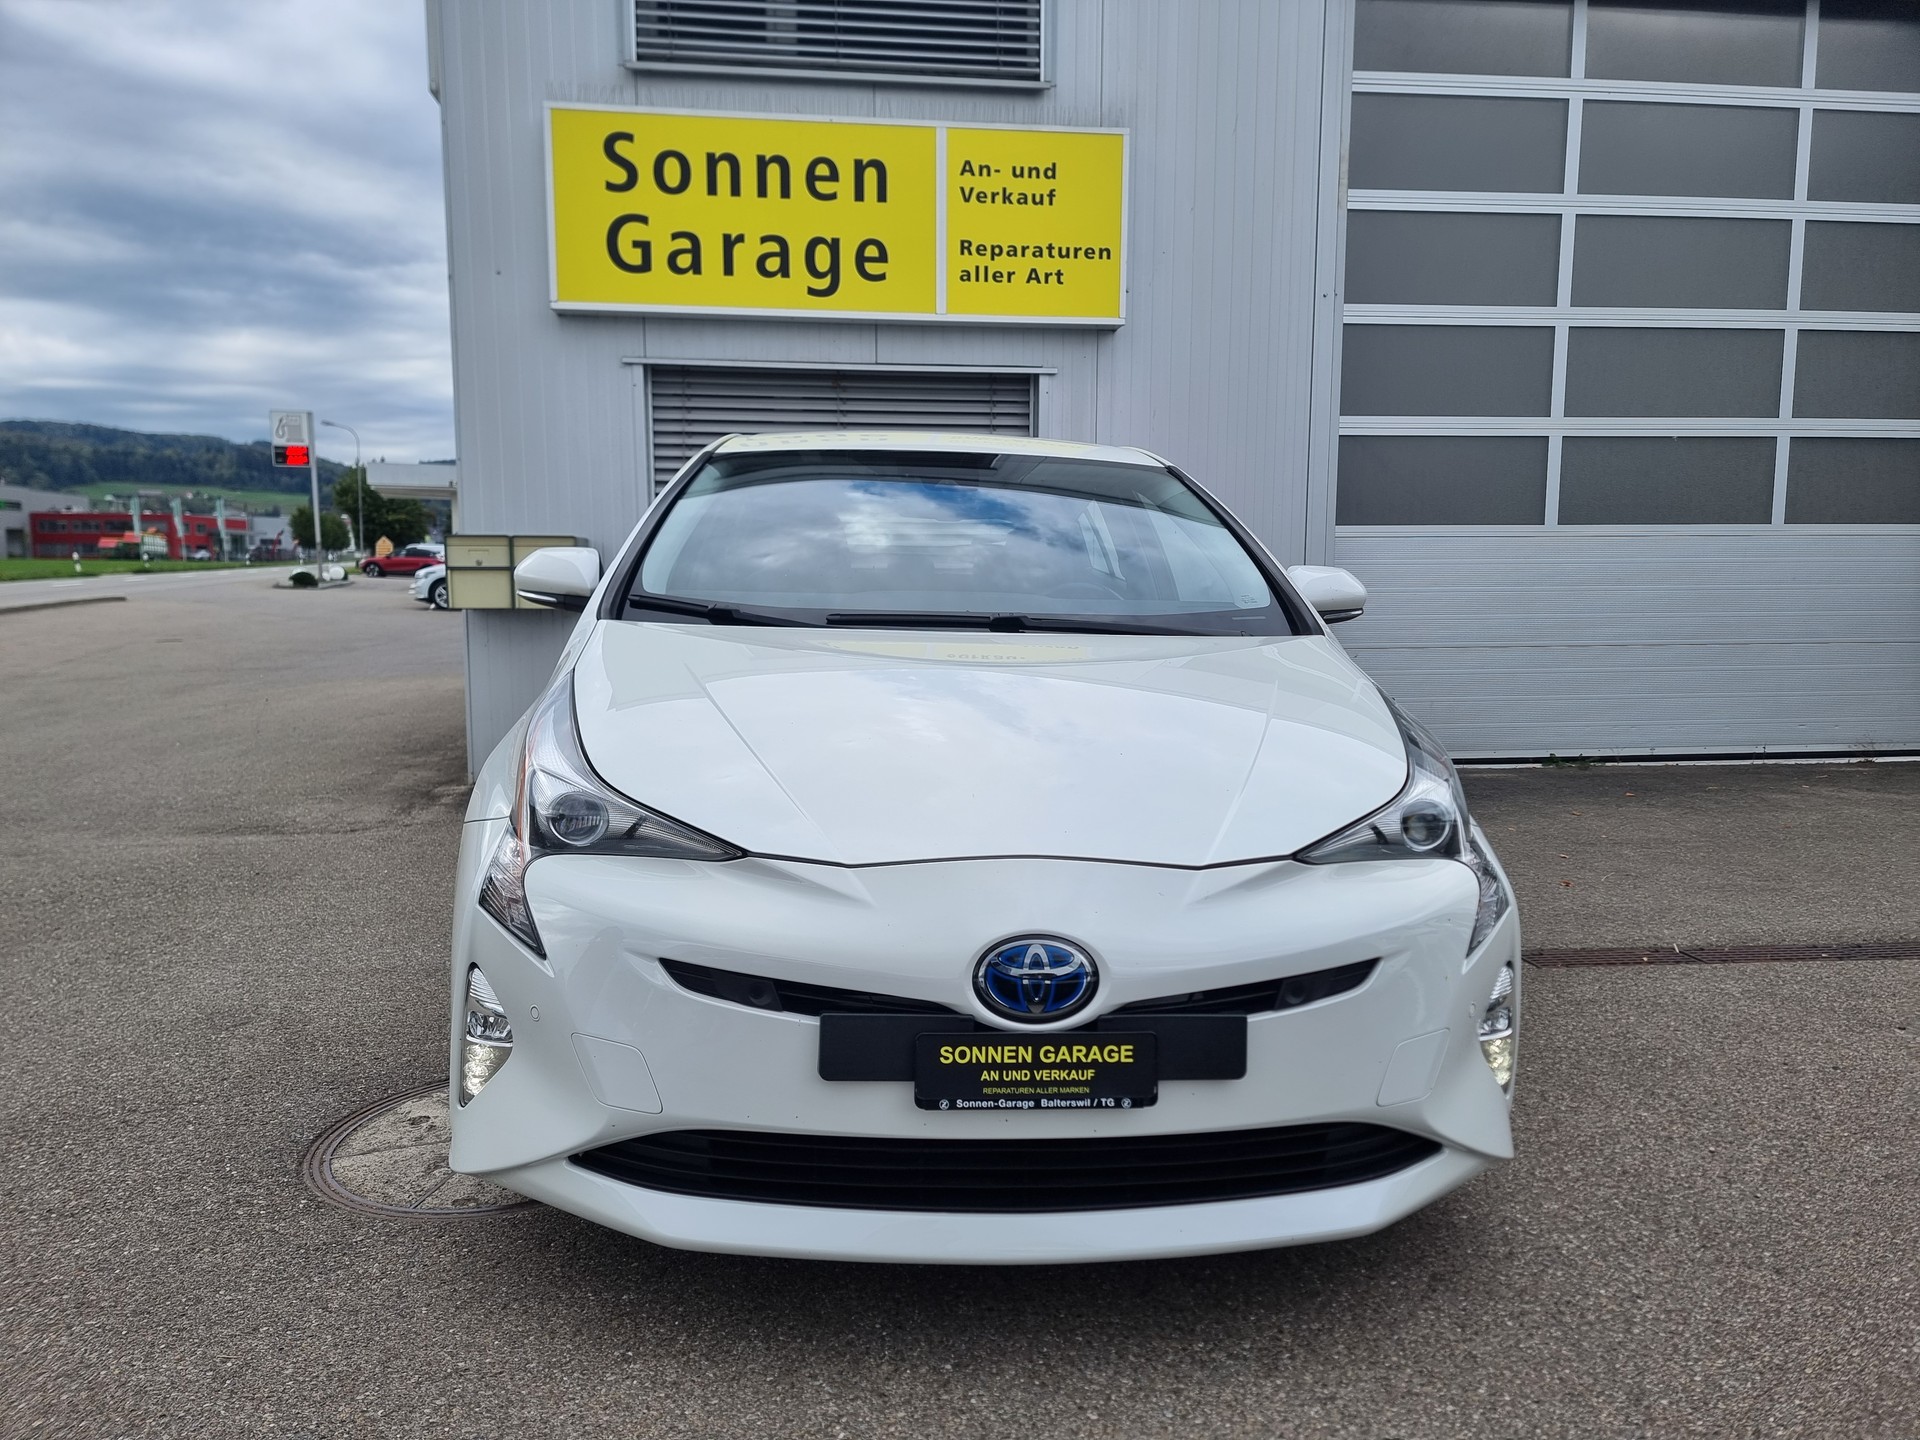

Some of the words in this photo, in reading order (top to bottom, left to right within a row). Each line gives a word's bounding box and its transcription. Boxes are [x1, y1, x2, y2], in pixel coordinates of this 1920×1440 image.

[602, 130, 888, 204] Sonnen
[959, 159, 1001, 178] An-
[1011, 161, 1057, 180] und
[959, 186, 1057, 207] Verkauf
[605, 212, 889, 298] Garage
[959, 239, 1112, 262] Reparaturen
[959, 265, 1017, 284] aller
[1025, 267, 1064, 285] Art
[939, 1045, 1032, 1064] SONNEN
[1039, 1045, 1134, 1064] GARAGE
[980, 1070, 999, 1081] AN
[1002, 1070, 1031, 1081] UND
[1033, 1069, 1095, 1081] VERKAUF
[982, 1086, 1036, 1095] REPARATUREN
[1036, 1086, 1059, 1095] ALLER
[1059, 1086, 1090, 1095] MARKEN
[956, 1098, 1035, 1110] Sonnen-Garage
[1040, 1097, 1091, 1108] Balterswil
[1093, 1098, 1098, 1108] /
[1100, 1097, 1115, 1108] TG
